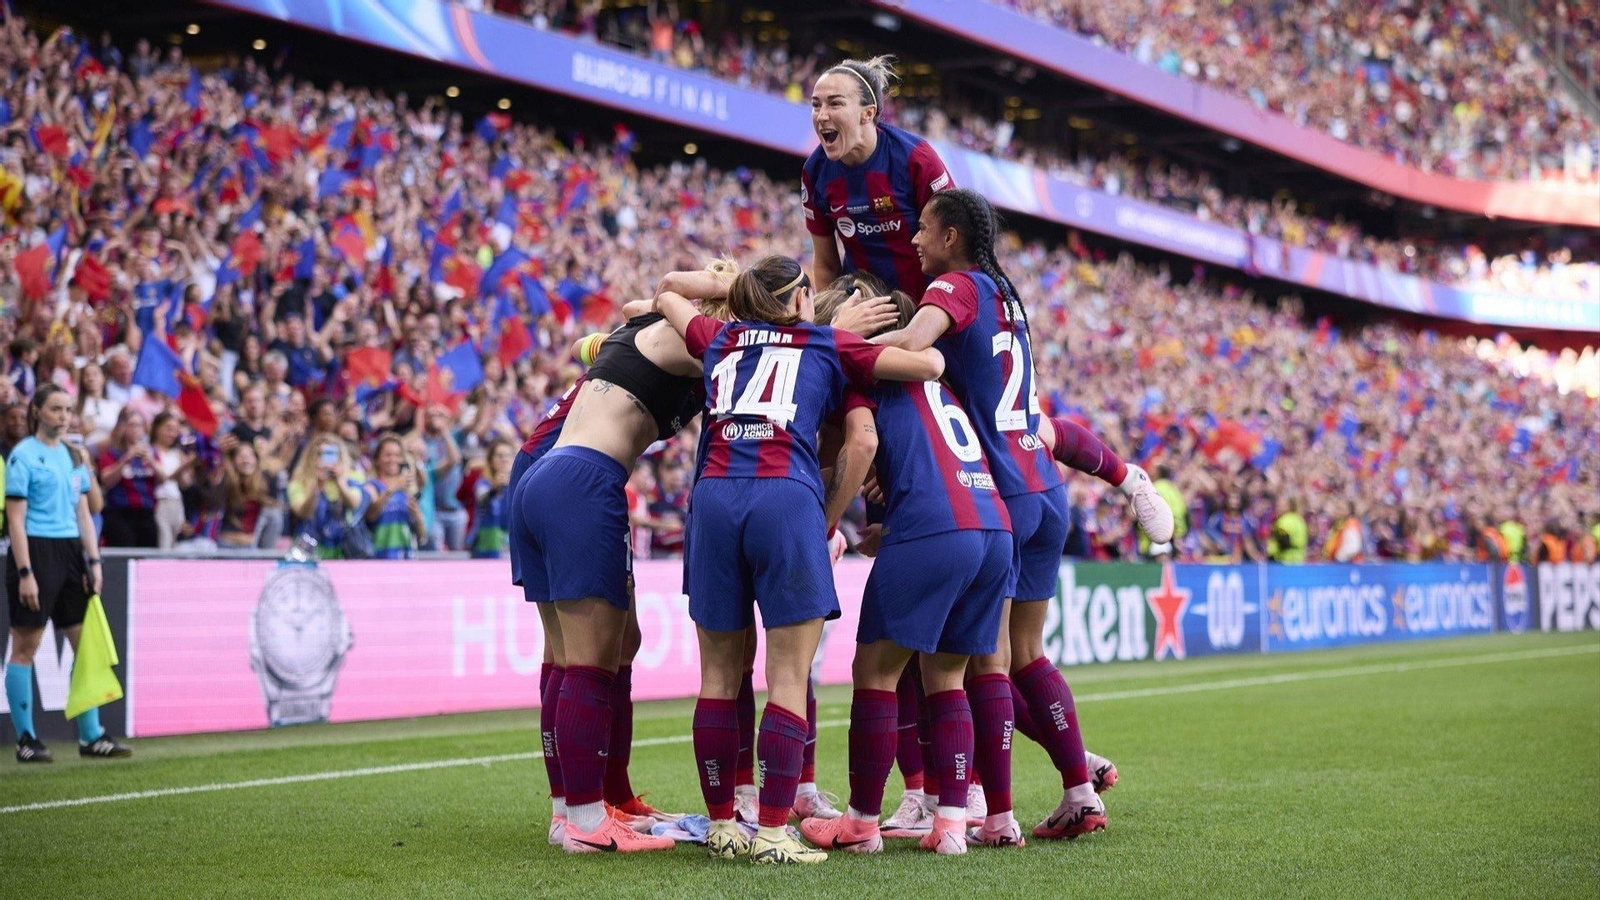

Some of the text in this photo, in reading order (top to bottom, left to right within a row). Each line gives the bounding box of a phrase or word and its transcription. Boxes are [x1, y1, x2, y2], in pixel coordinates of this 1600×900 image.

[857, 219, 901, 236] Spotify
[736, 329, 793, 347] AITANA
[709, 345, 804, 431] 14
[743, 430, 774, 438] ACNUR
[744, 422, 774, 431] UNHCR
[923, 380, 982, 463] 6
[1041, 562, 1150, 666] eken
[1282, 568, 1388, 642] euronics
[1403, 566, 1493, 634] euronics
[451, 592, 696, 676] HUOT
[1048, 700, 1070, 732] BARÇA
[542, 731, 555, 758] BARÇA
[1001, 719, 1014, 751] BARÇA
[705, 758, 720, 787] BARÇA
[955, 752, 968, 781] BARÇA
